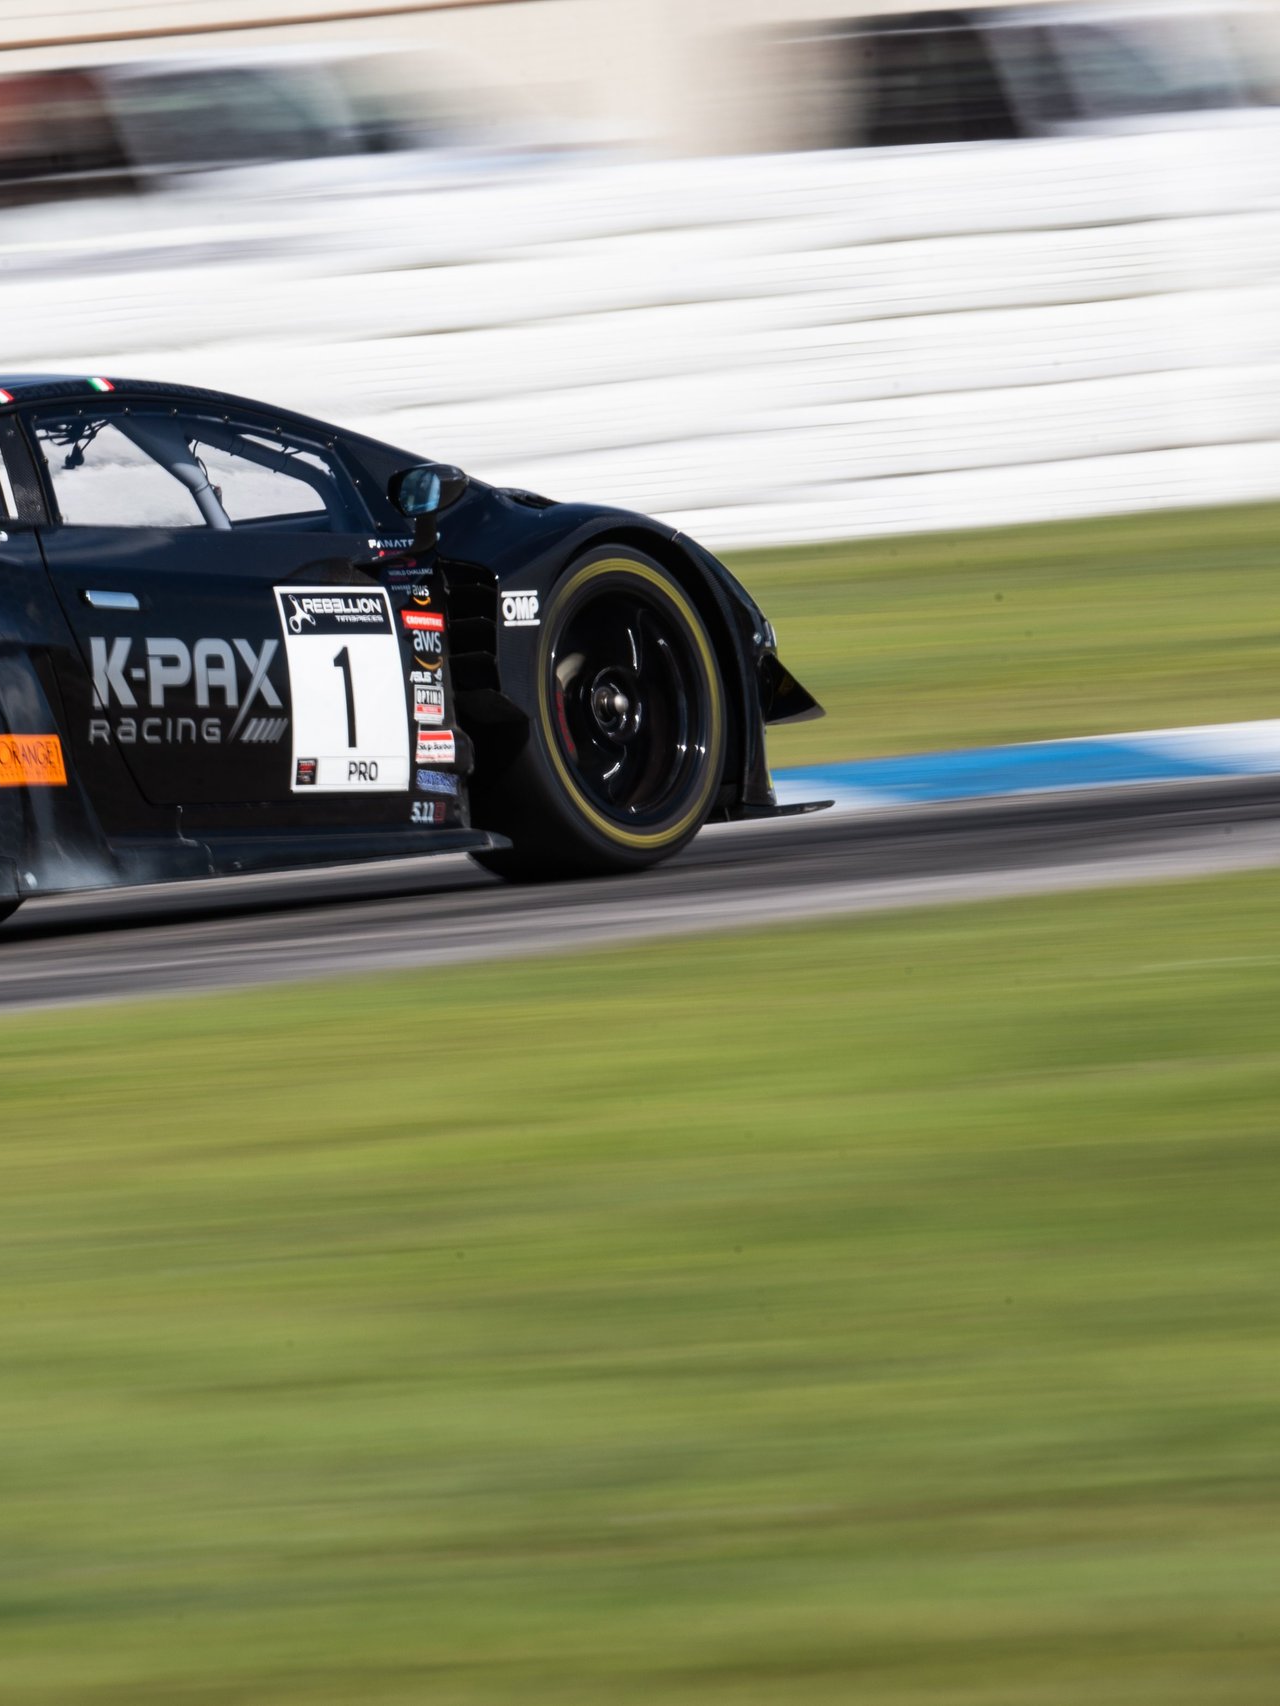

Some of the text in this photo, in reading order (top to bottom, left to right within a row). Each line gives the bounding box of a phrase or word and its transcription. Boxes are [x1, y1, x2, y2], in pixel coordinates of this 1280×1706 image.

[368, 539, 415, 549] FANATE
[412, 584, 430, 597] aws
[302, 598, 383, 614] REBELLION
[502, 596, 539, 621] OMP
[412, 629, 442, 654] aws
[89, 636, 284, 709] K-PAX
[409, 670, 432, 683] ASUS
[333, 645, 357, 749] 1
[347, 761, 379, 782] PRO
